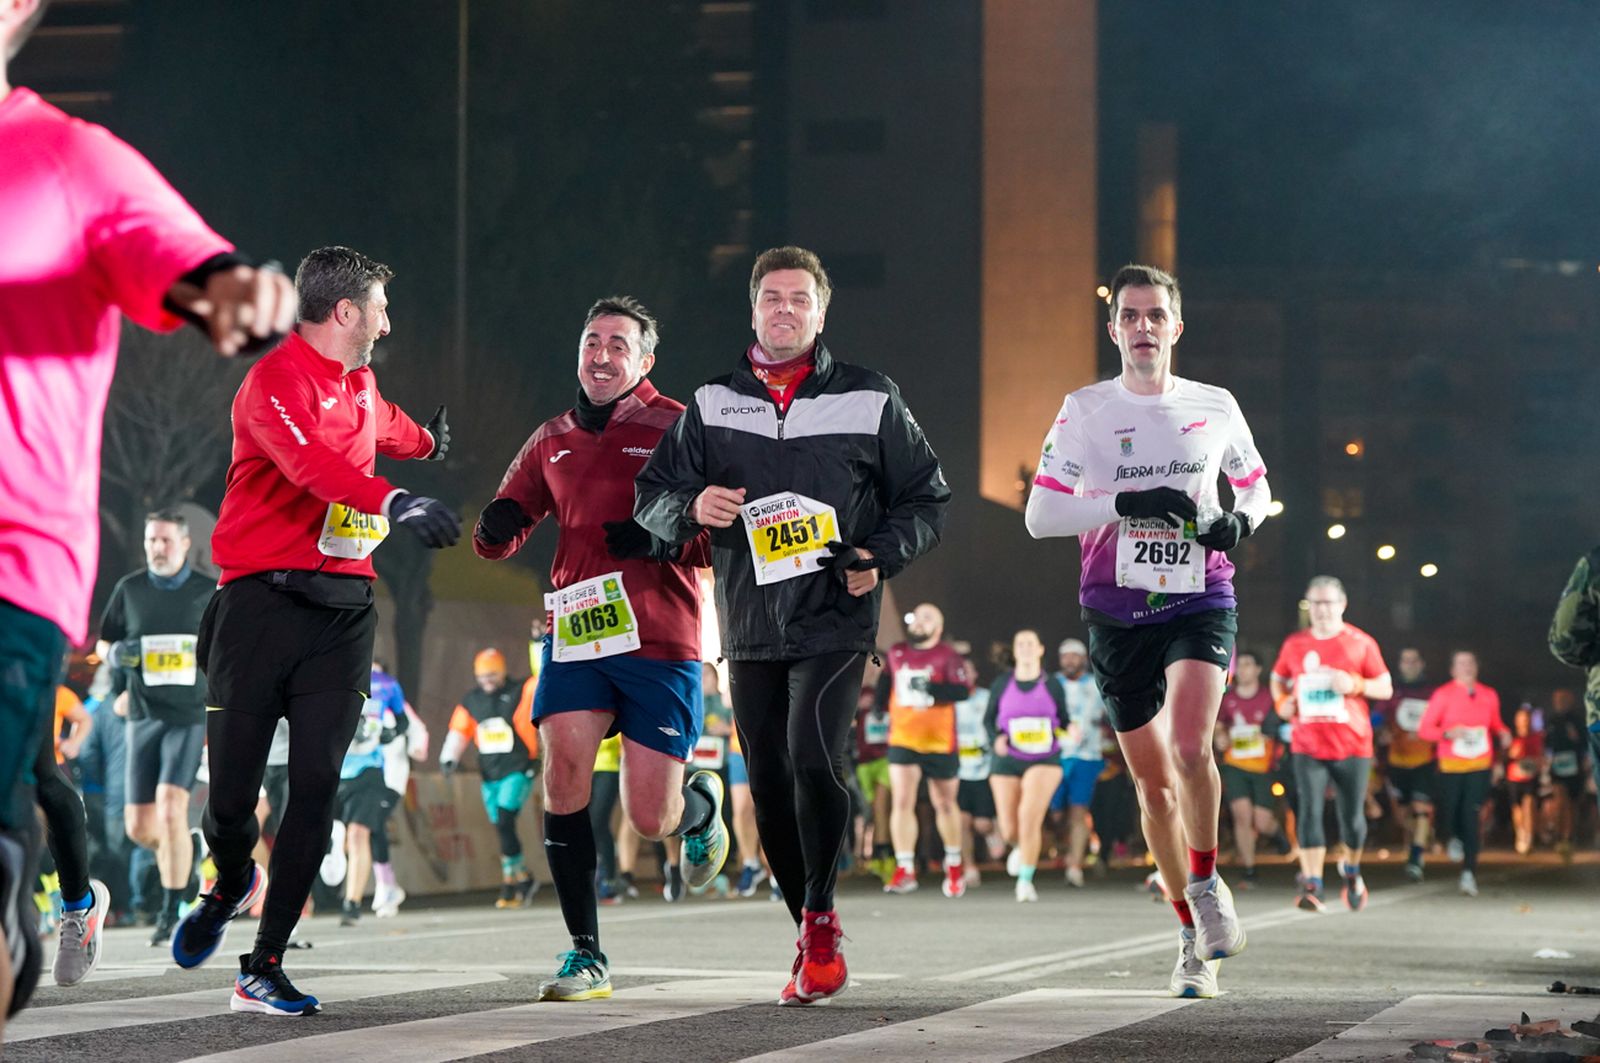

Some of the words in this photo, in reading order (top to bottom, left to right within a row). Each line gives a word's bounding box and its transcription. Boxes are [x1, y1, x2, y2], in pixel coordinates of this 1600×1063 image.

[721, 406, 767, 416] GIVOVA
[1113, 465, 1154, 482] SIERRA
[1155, 466, 1167, 474] DE
[1164, 460, 1206, 478] SEGURA
[761, 501, 785, 516] NOCHE
[786, 499, 798, 508] DE
[755, 515, 771, 529] SAN
[772, 508, 800, 524] ANTÓN
[1139, 519, 1165, 529] NOCHE
[766, 515, 820, 552] 2451
[1128, 530, 1146, 539] SAN
[1148, 529, 1178, 540] ANTÓN
[1134, 541, 1191, 565] 2692
[588, 586, 597, 596] DE
[570, 603, 619, 638] 8163
